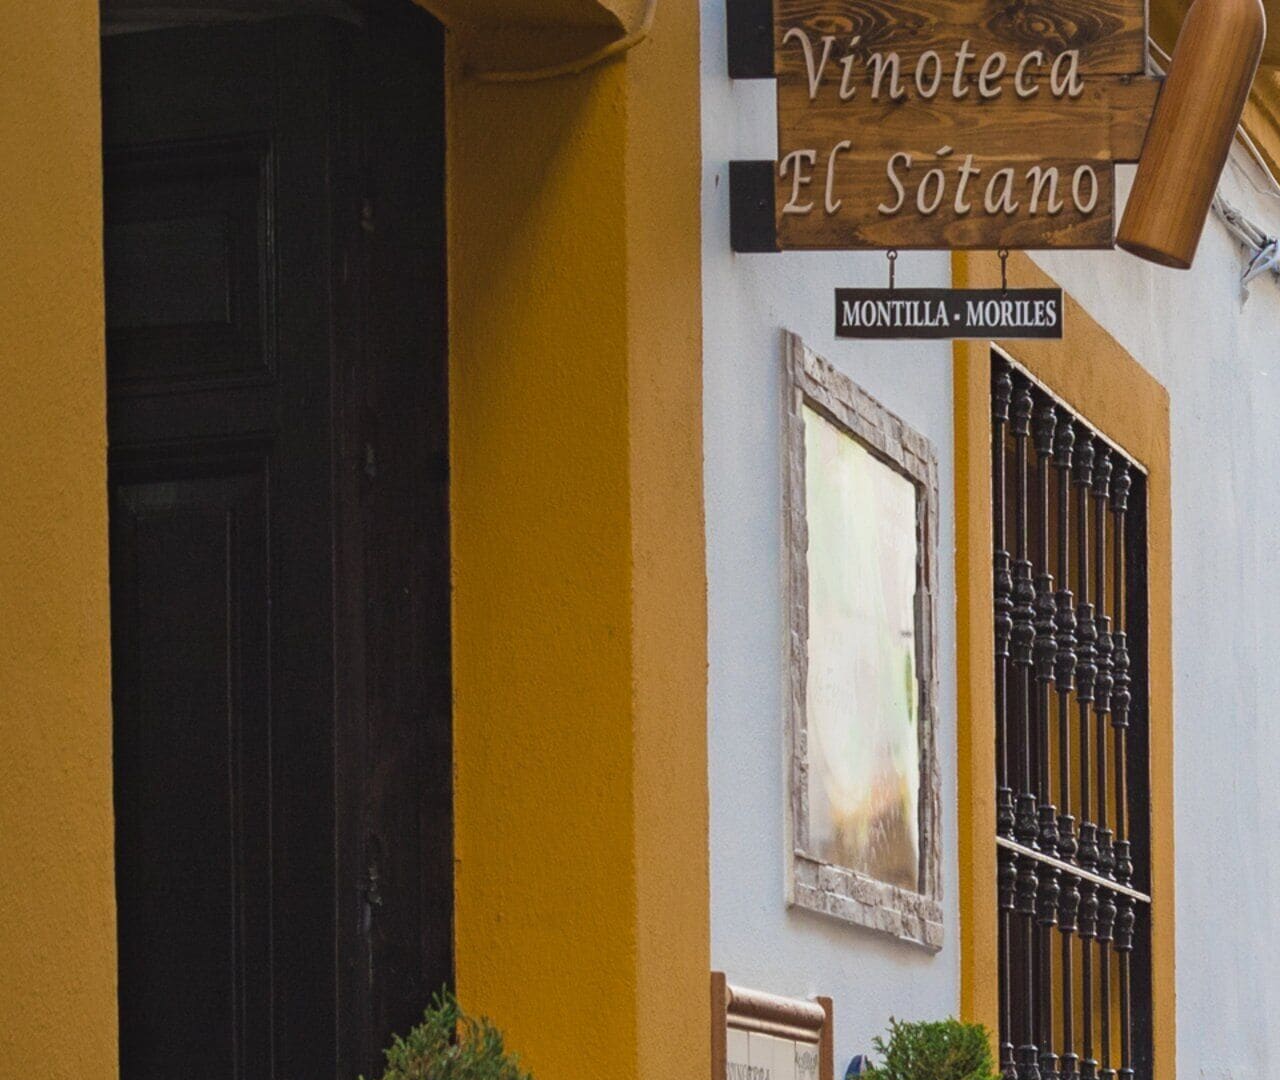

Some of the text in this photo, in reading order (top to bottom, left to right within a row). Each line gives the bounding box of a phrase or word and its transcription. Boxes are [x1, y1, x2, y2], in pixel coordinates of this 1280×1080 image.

[782, 27, 1086, 101] Vinoteca
[779, 139, 1099, 217] El Sótano
[841, 300, 949, 329] MONTILLA
[965, 299, 1057, 328] MORILES
